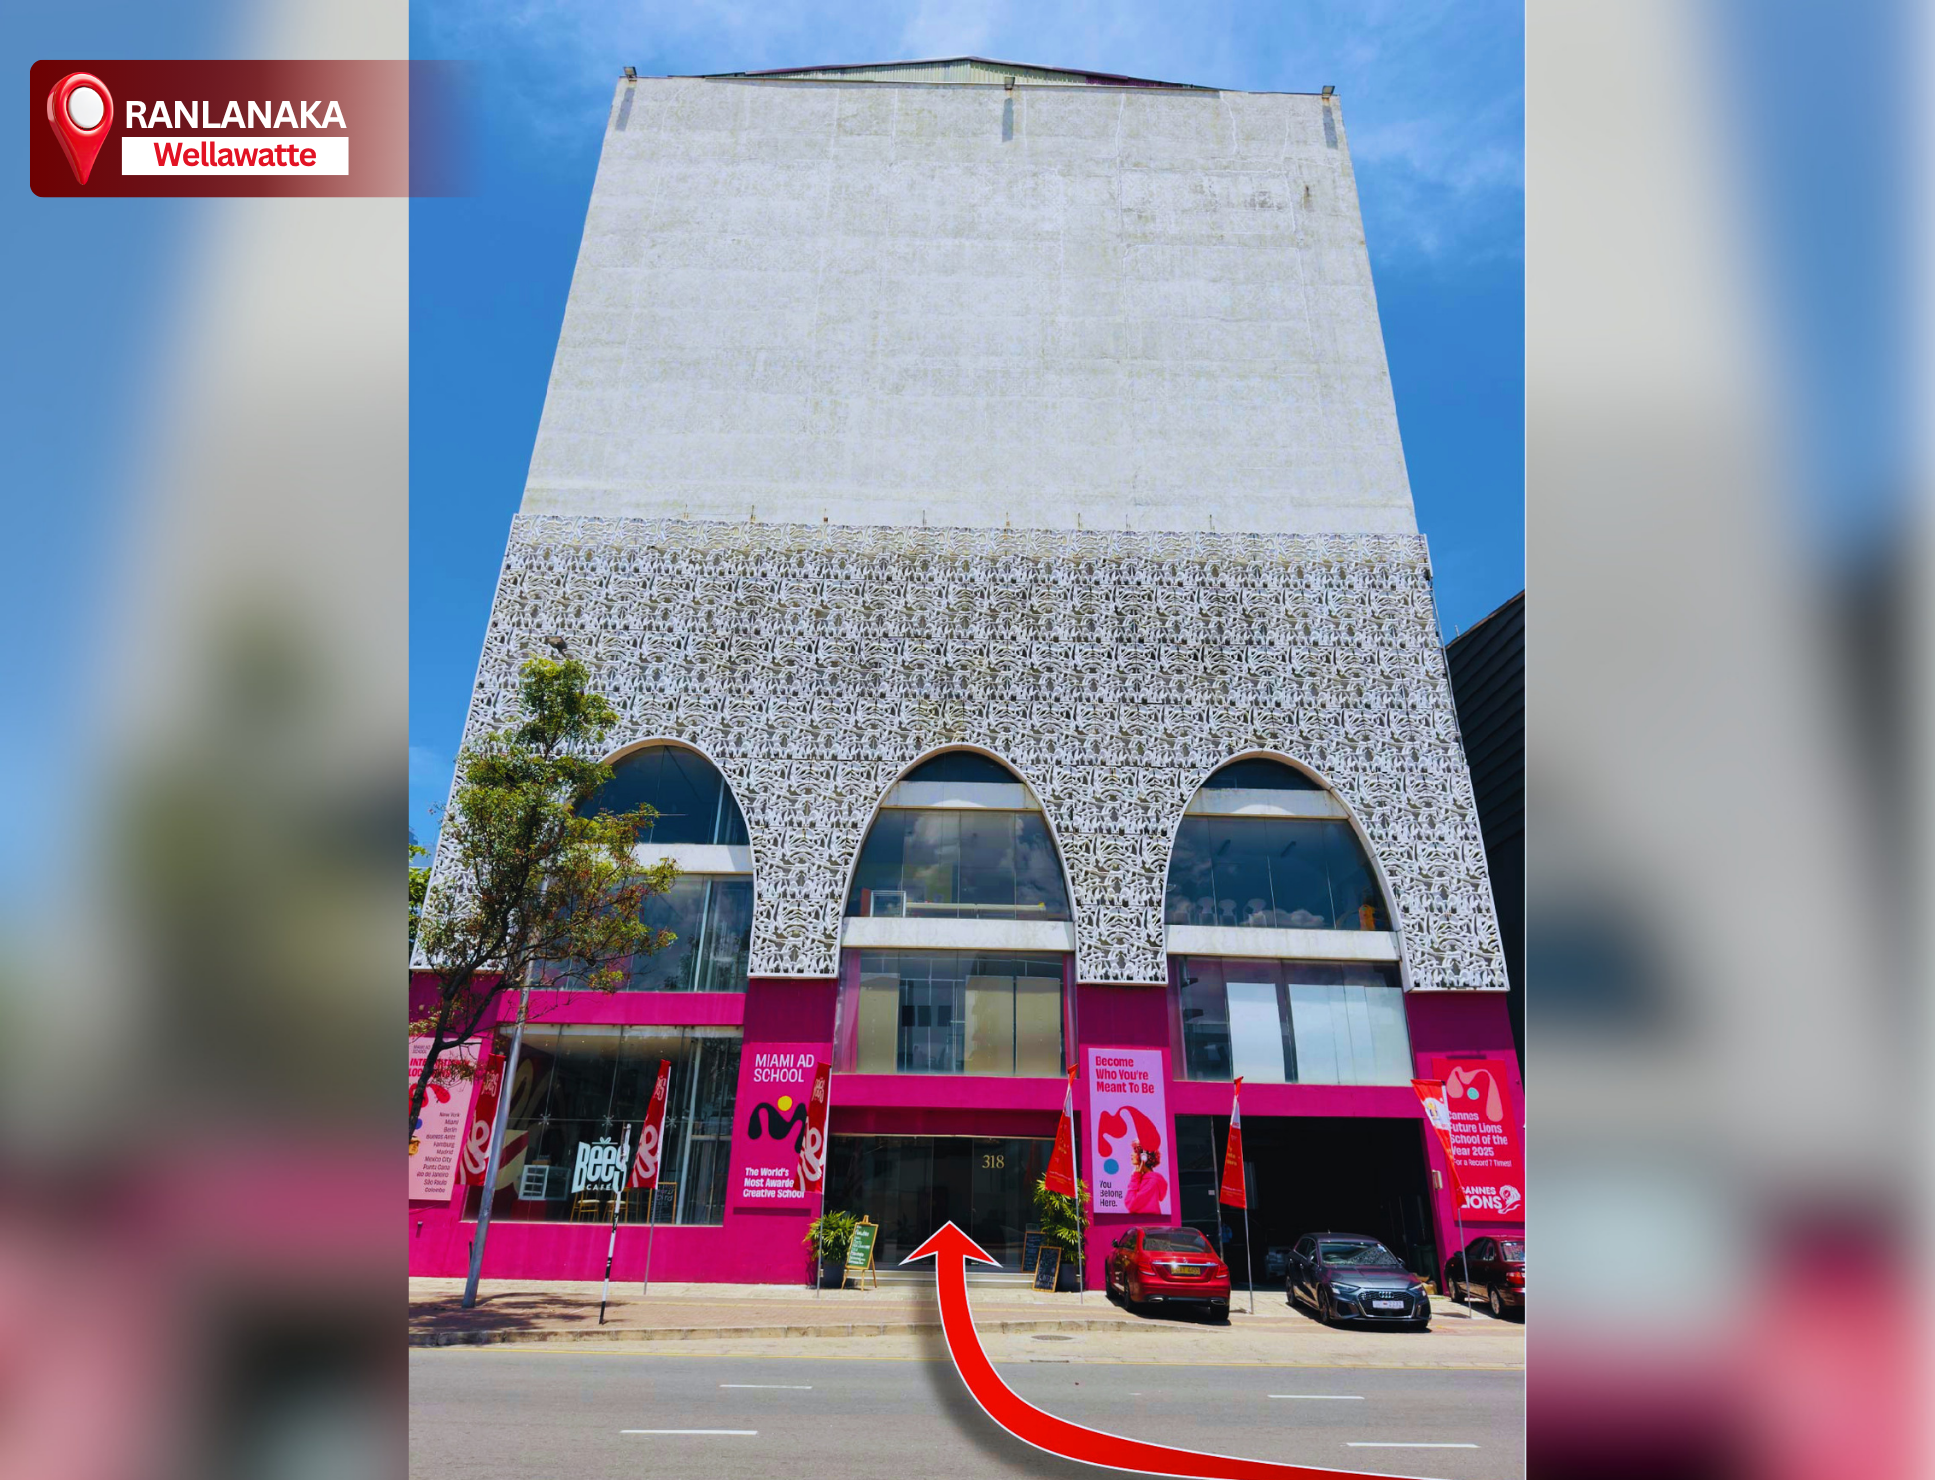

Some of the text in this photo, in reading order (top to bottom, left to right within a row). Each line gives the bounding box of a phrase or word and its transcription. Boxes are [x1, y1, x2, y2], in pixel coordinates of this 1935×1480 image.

[755, 1053, 815, 1068] MIAMI AD
[1095, 1055, 1134, 1068] Become
[753, 1068, 805, 1083] SCHOOL
[1095, 1068, 1149, 1080] Who You're
[1096, 1081, 1155, 1094] Meant To Be
[1478, 1123, 1503, 1134] Lions
[1450, 1134, 1508, 1145] School of the
[1471, 1146, 1495, 1156] 2025
[982, 1154, 1005, 1169] 318
[745, 1167, 790, 1177] The World's
[744, 1178, 795, 1188] Most Awarde
[1099, 1180, 1112, 1189] You
[743, 1189, 776, 1198] Creative
[1100, 1190, 1123, 1199] Belong
[1100, 1199, 1118, 1207] Here.
